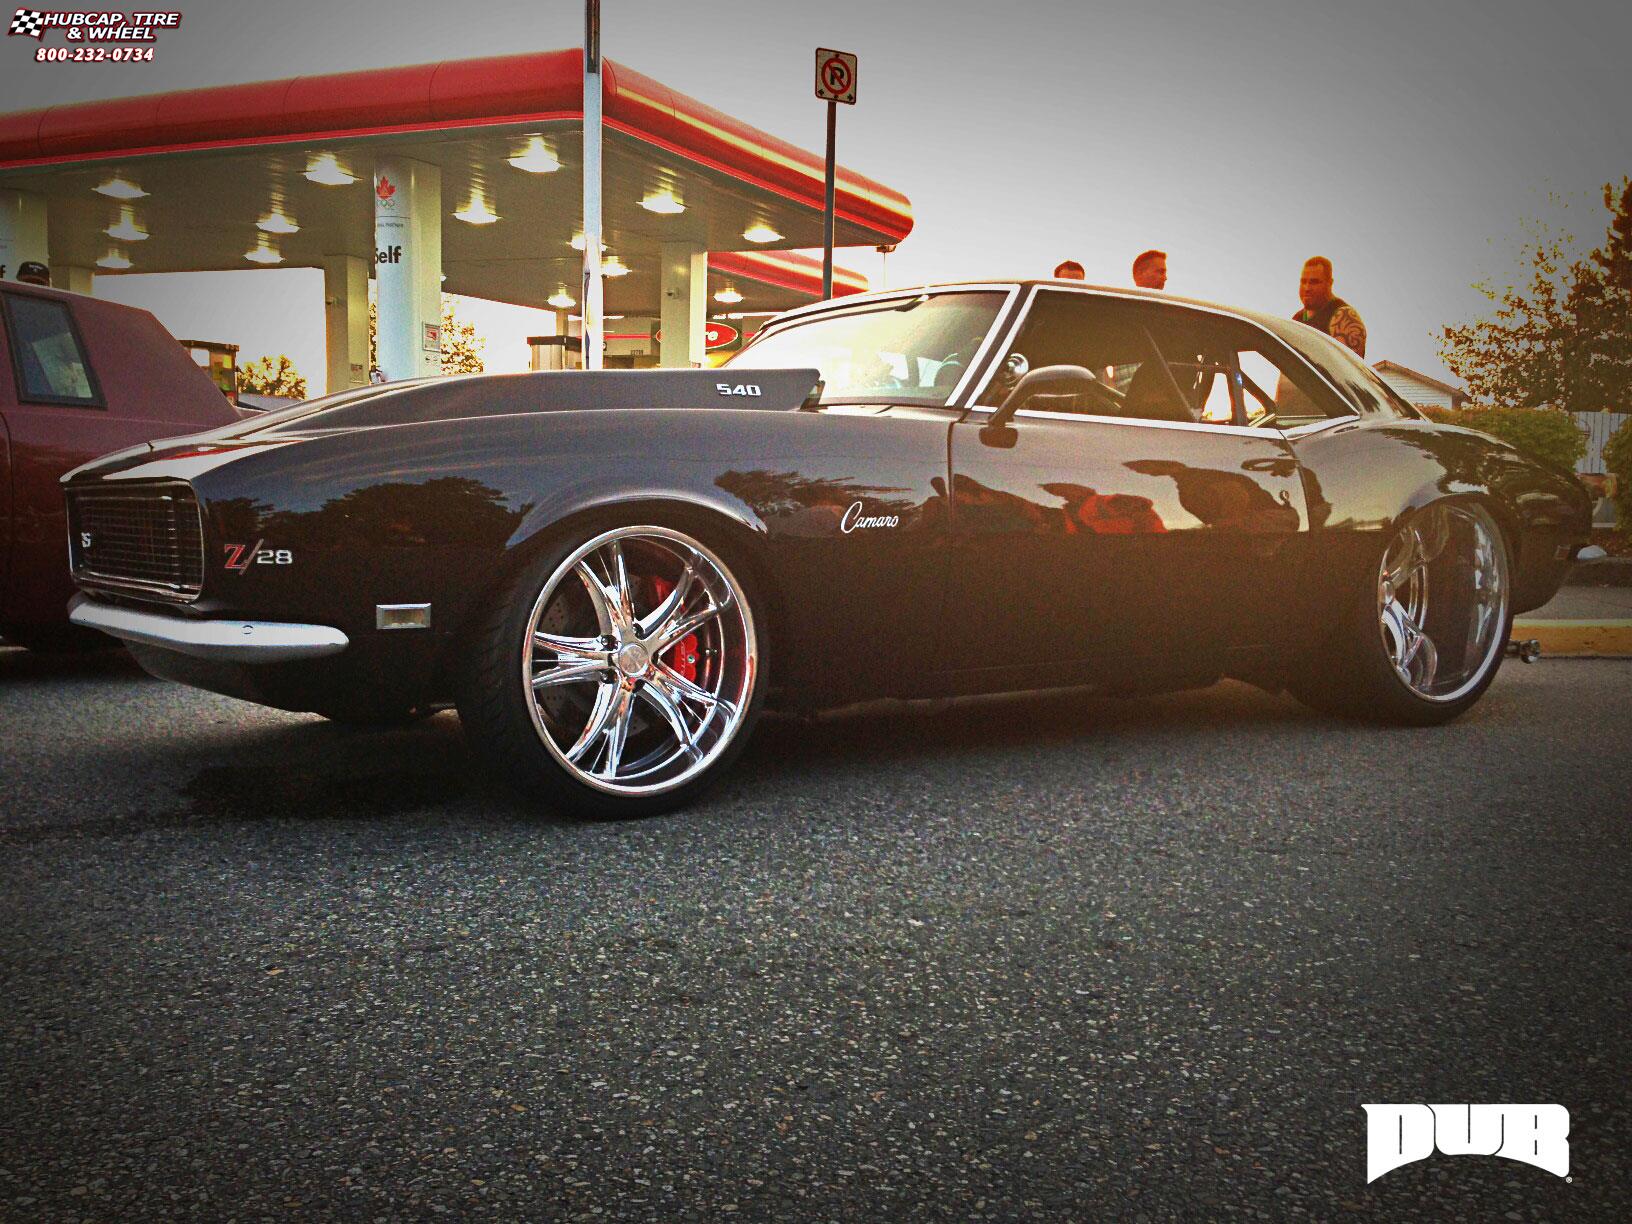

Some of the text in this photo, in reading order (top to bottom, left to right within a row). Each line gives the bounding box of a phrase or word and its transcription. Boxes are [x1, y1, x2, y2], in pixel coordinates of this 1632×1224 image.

[716, 383, 762, 397] 540
[840, 500, 900, 534] Camaro
[223, 538, 294, 576] Z/28
